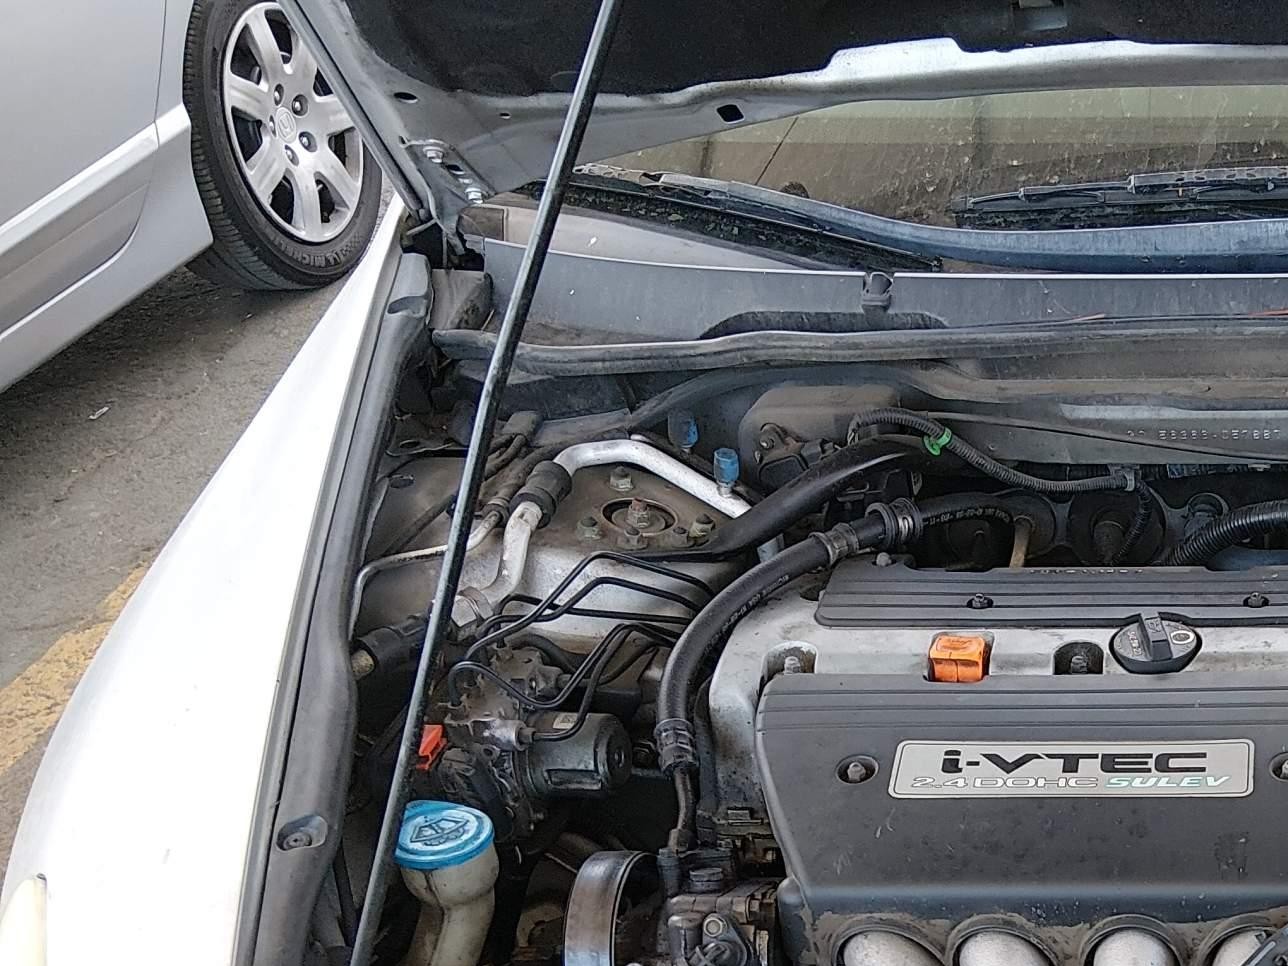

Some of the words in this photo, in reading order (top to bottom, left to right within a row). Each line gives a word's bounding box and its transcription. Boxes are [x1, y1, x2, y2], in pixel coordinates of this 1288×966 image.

[941, 749, 1208, 774] i-VTEC
[910, 775, 969, 789] 2.4
[973, 776, 1099, 789] DOHC
[1105, 775, 1231, 788] SULEV
